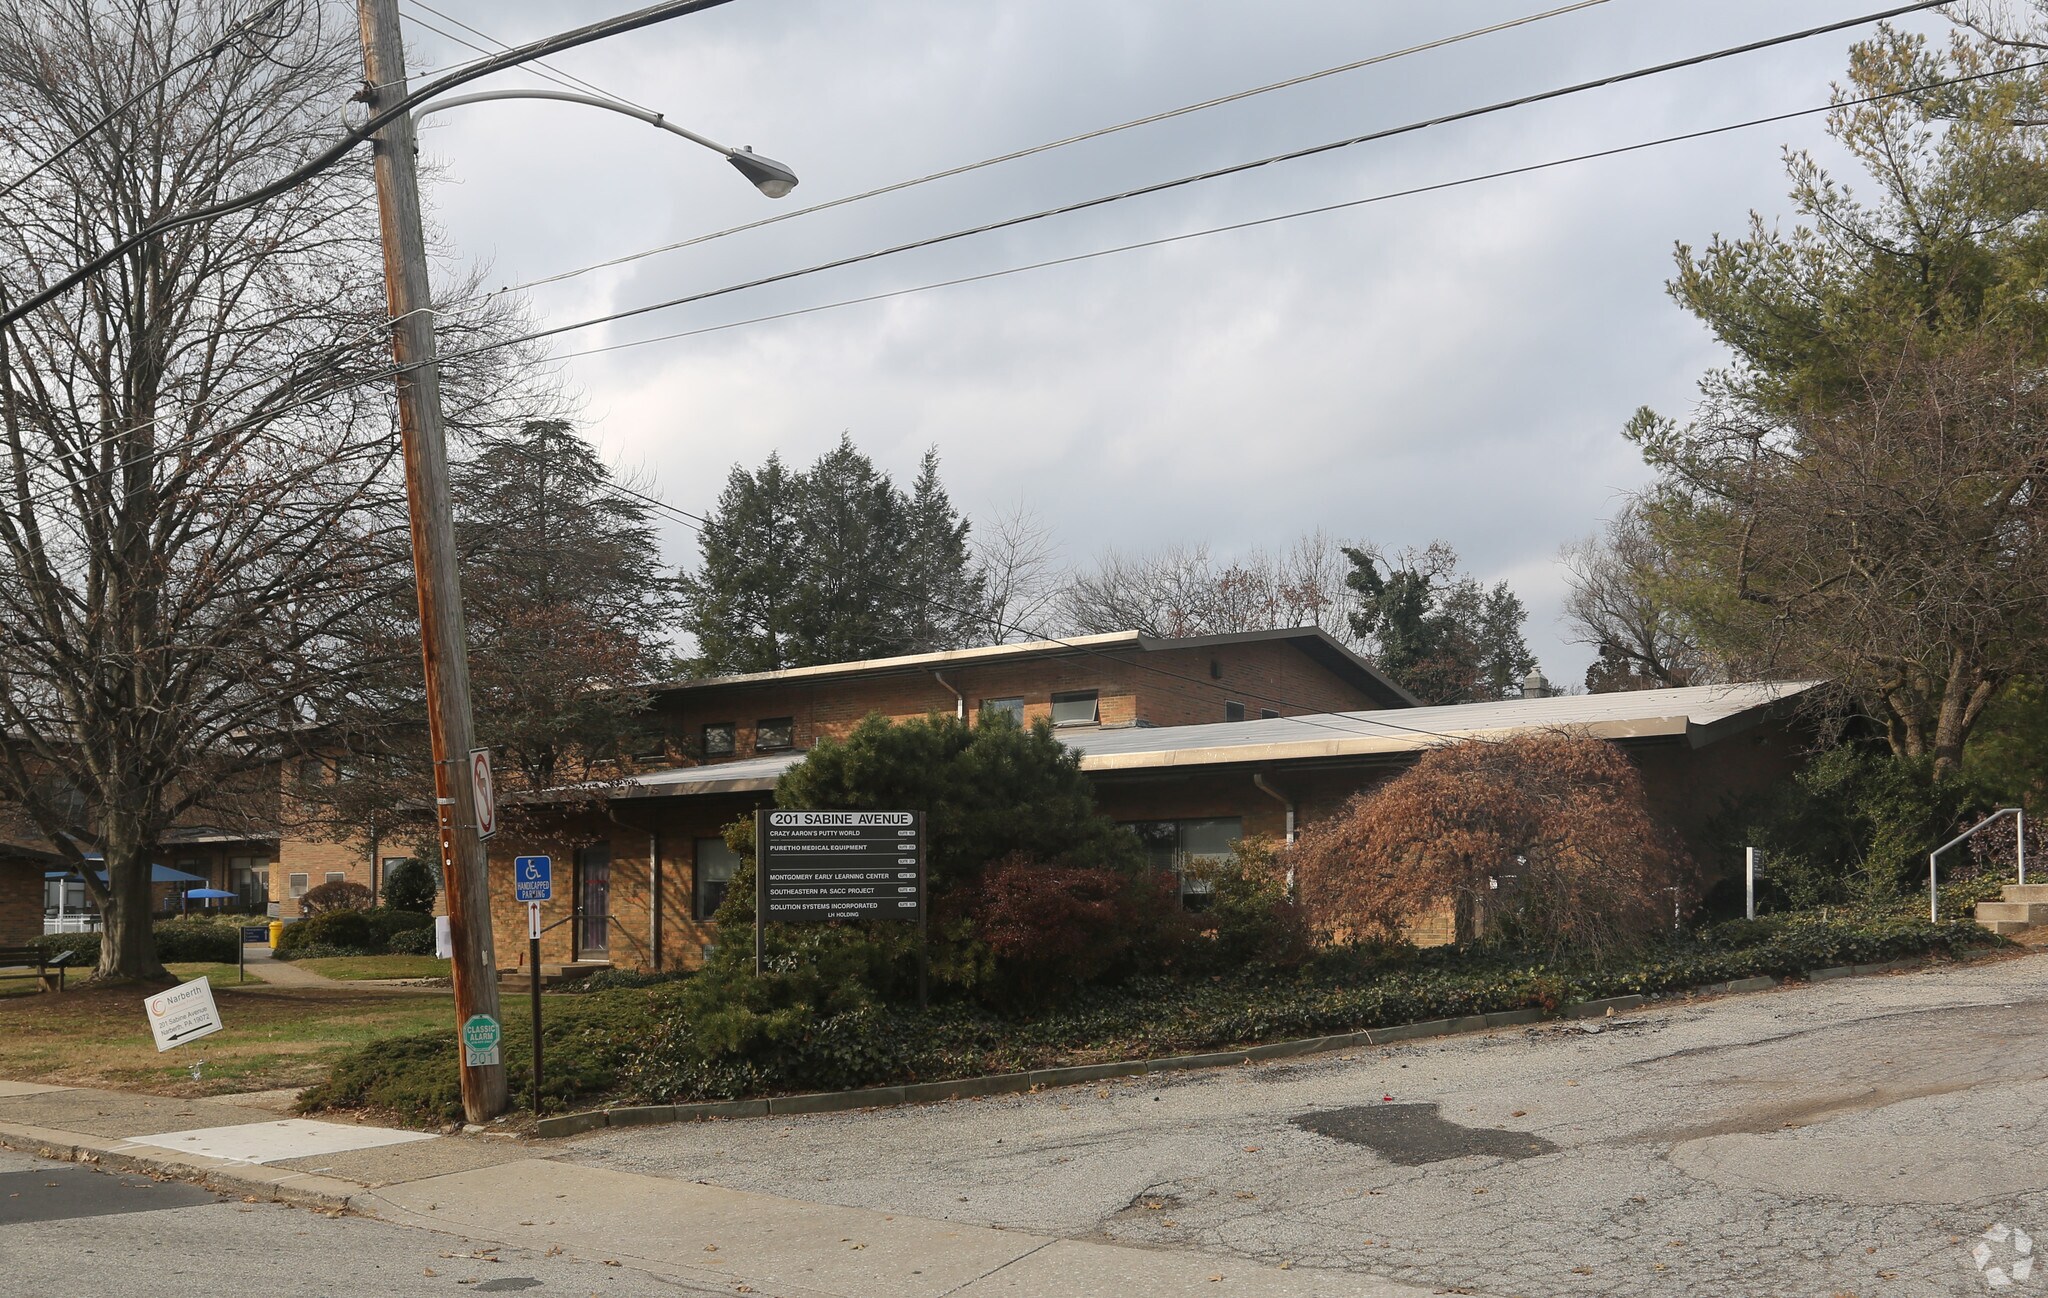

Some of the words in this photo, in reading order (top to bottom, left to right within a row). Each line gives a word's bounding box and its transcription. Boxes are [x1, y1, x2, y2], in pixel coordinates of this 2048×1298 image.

[775, 814, 798, 825] 201
[804, 814, 853, 825] SABINE
[858, 814, 909, 825] AVENUE
[769, 873, 813, 881] MONTGOMERY
[517, 881, 550, 891] HANDICAPPED
[770, 903, 801, 911] SOLUTION
[831, 902, 878, 910] INCORPORATED
[166, 986, 202, 1005] Narberth
[159, 1021, 168, 1029] 201
[168, 1015, 187, 1025] Sabine
[187, 1007, 208, 1018] Avenue
[184, 1020, 193, 1028] PA
[193, 1014, 210, 1024] 19072
[467, 1025, 496, 1034] CLASSIC
[470, 1033, 494, 1041] ALARM
[470, 1053, 494, 1065] 201
